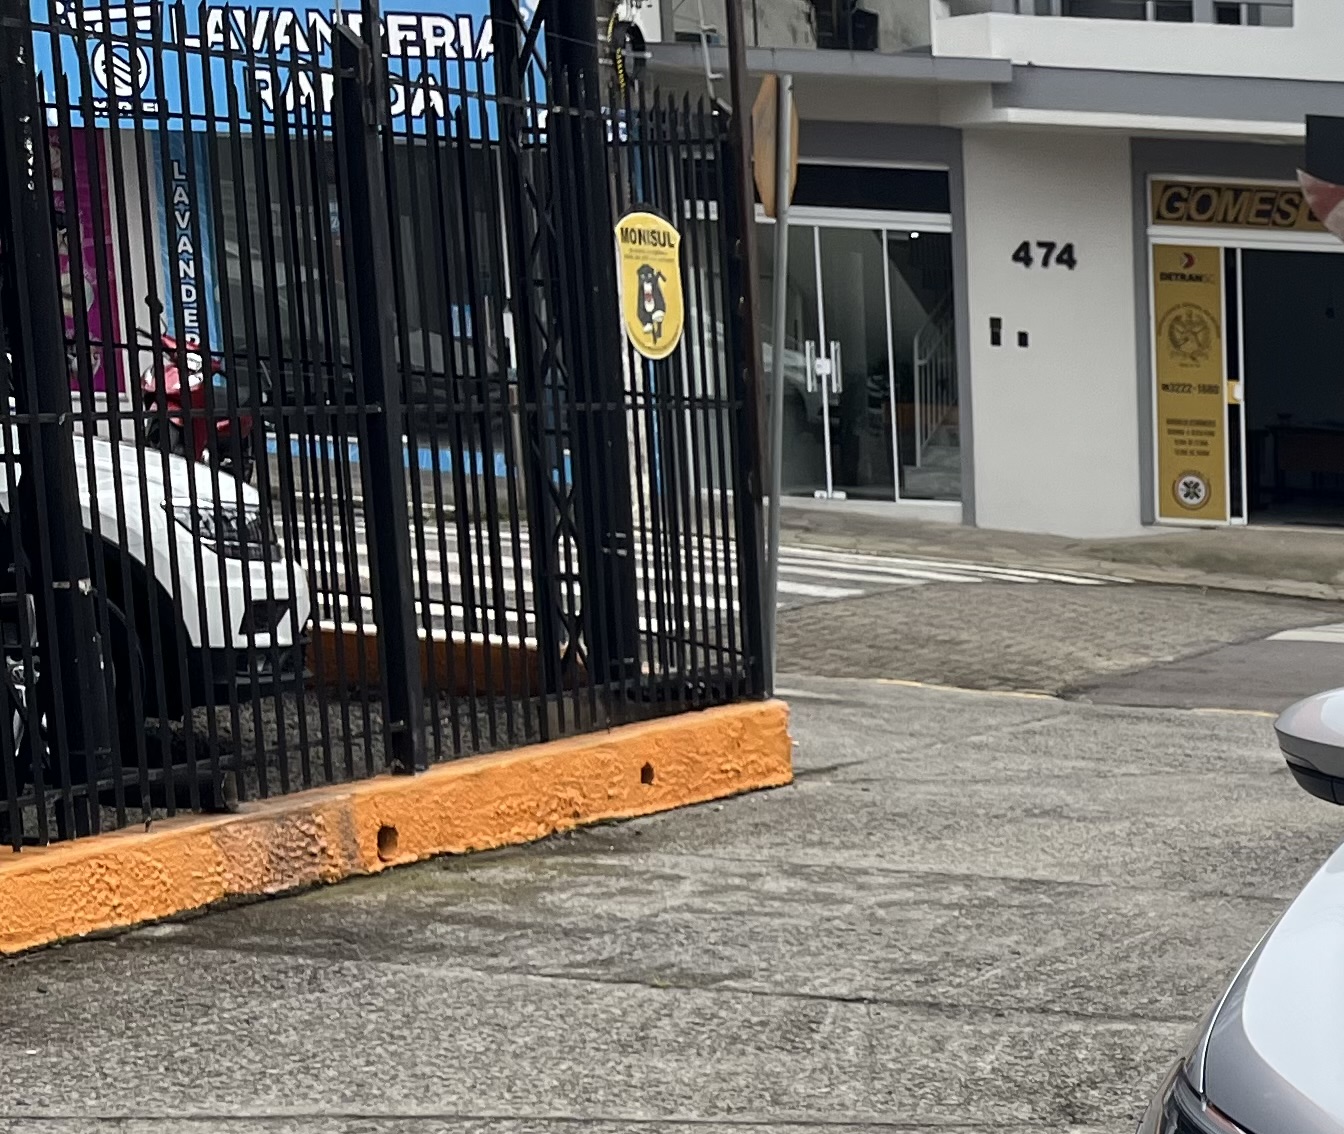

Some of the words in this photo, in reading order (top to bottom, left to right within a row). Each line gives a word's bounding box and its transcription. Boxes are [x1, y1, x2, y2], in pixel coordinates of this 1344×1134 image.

[1157, 185, 1303, 228] GOMES
[171, 161, 201, 346] LAVANDER
[620, 227, 675, 248] MONISUL
[1011, 240, 1078, 271] 474
